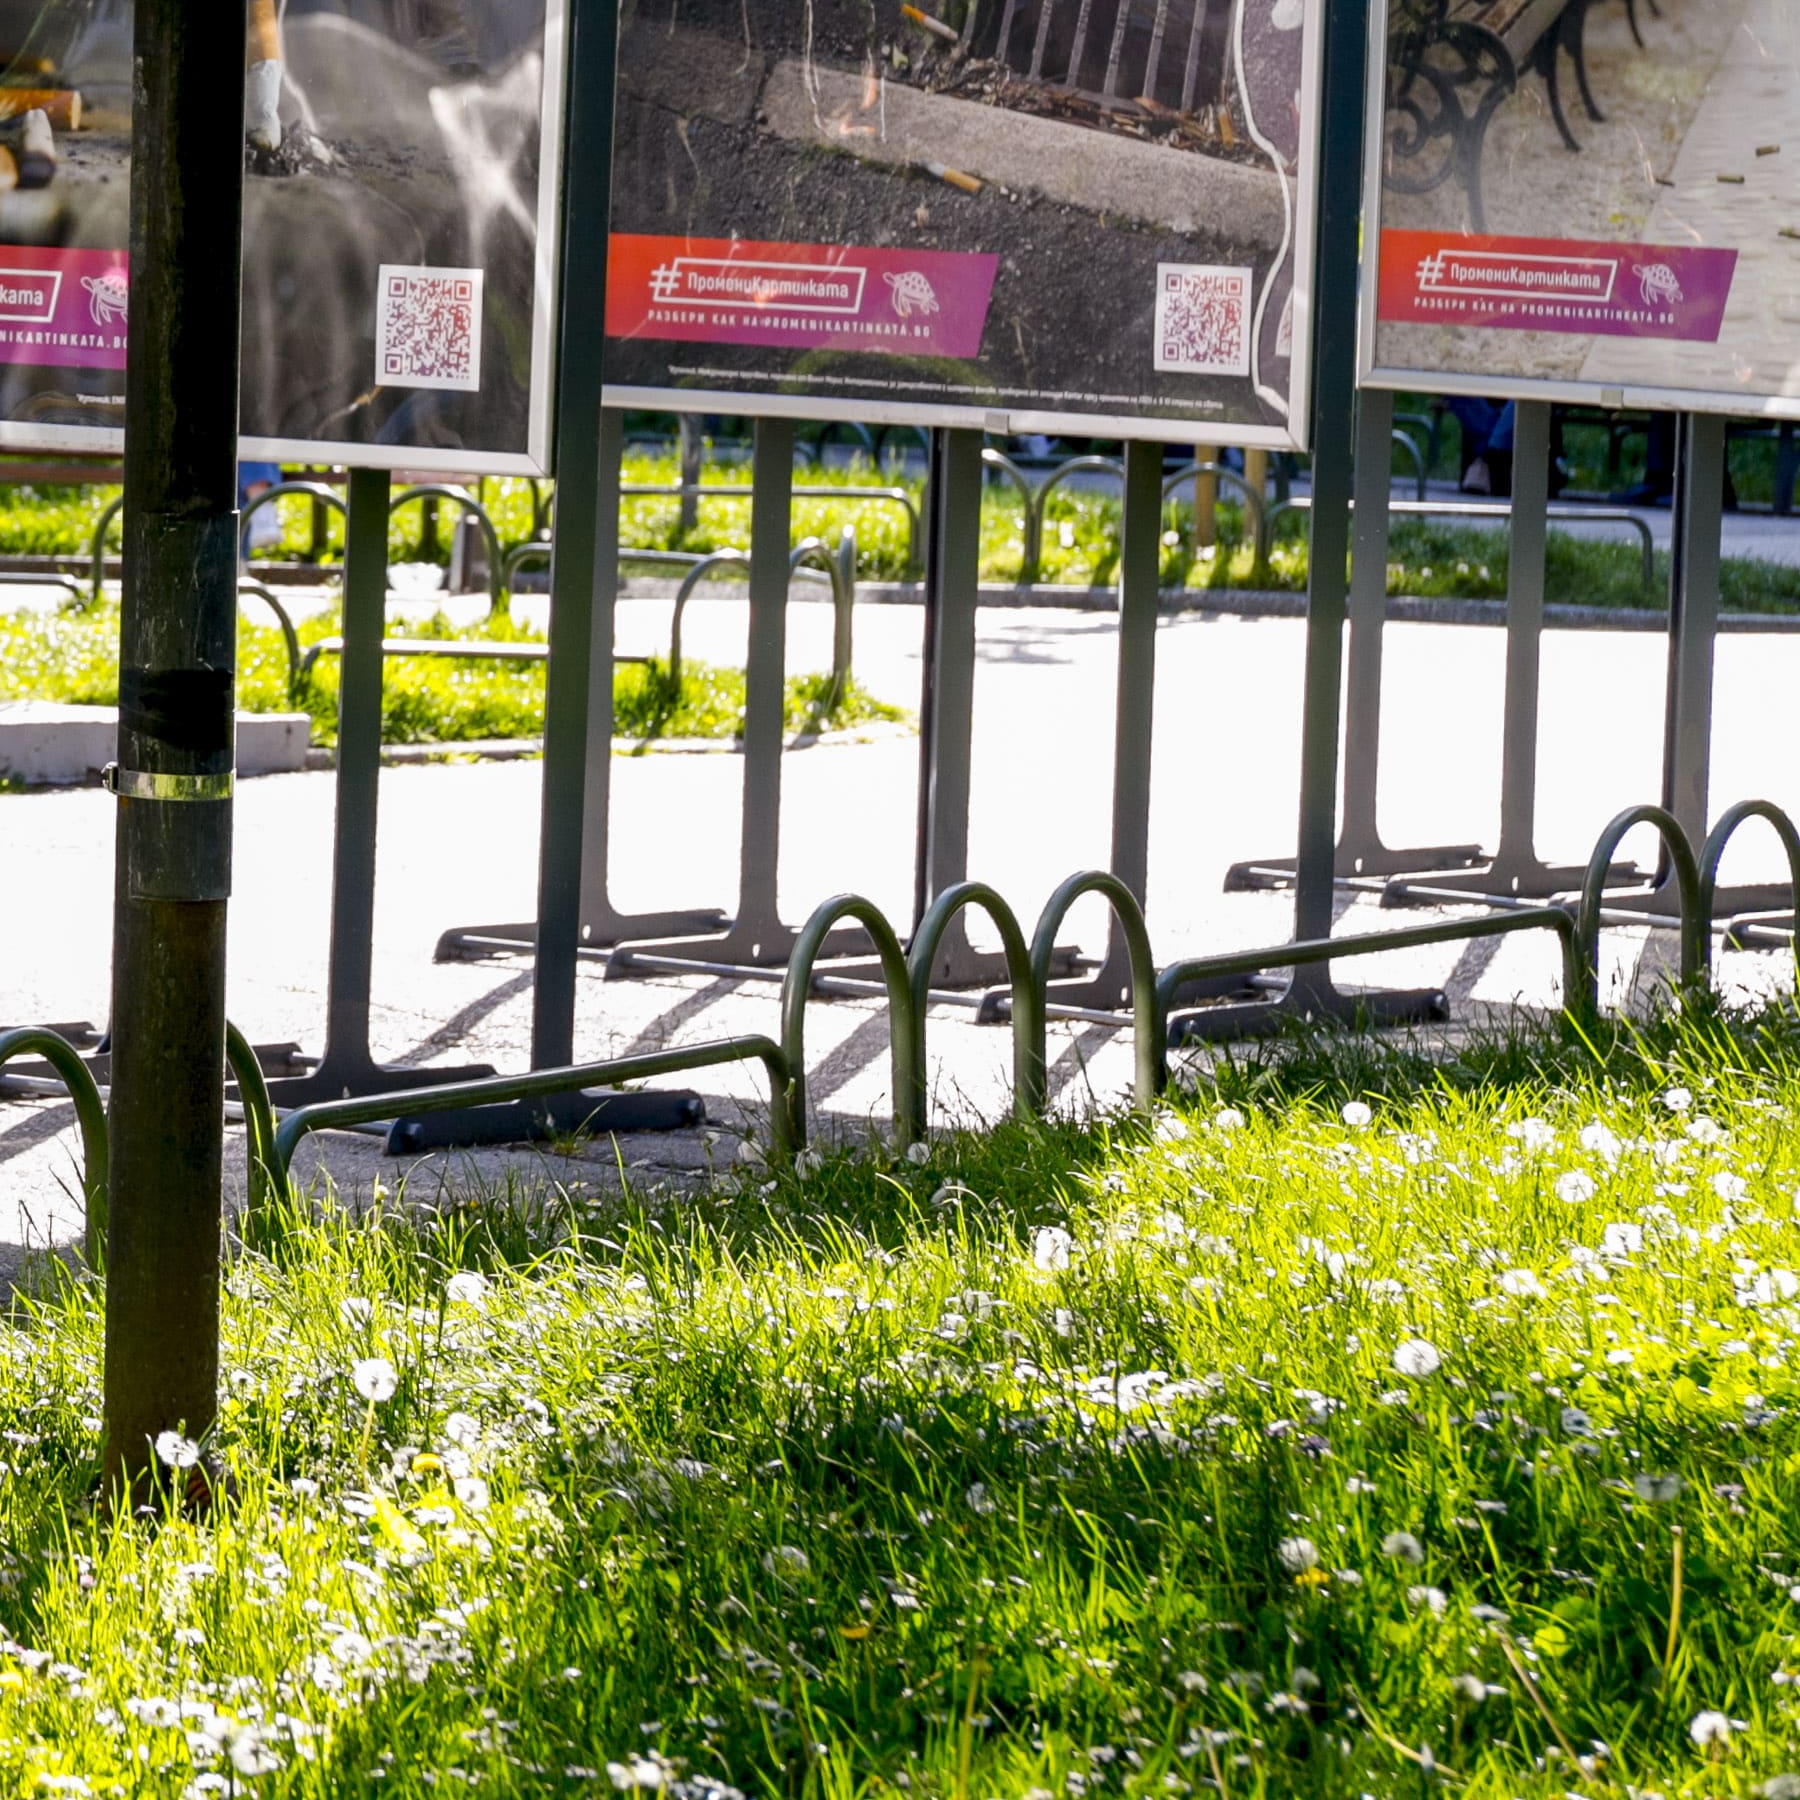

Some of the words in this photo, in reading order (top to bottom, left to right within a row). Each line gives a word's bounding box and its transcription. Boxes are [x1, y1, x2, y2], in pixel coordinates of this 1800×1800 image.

[1414, 296, 1465, 311] РАЗБЕРИ
[1472, 300, 1495, 313] КАК
[1501, 302, 1515, 315] НА
[648, 309, 705, 324] РАЗБЕРИ
[712, 313, 736, 326] КАК
[743, 315, 758, 327] НА
